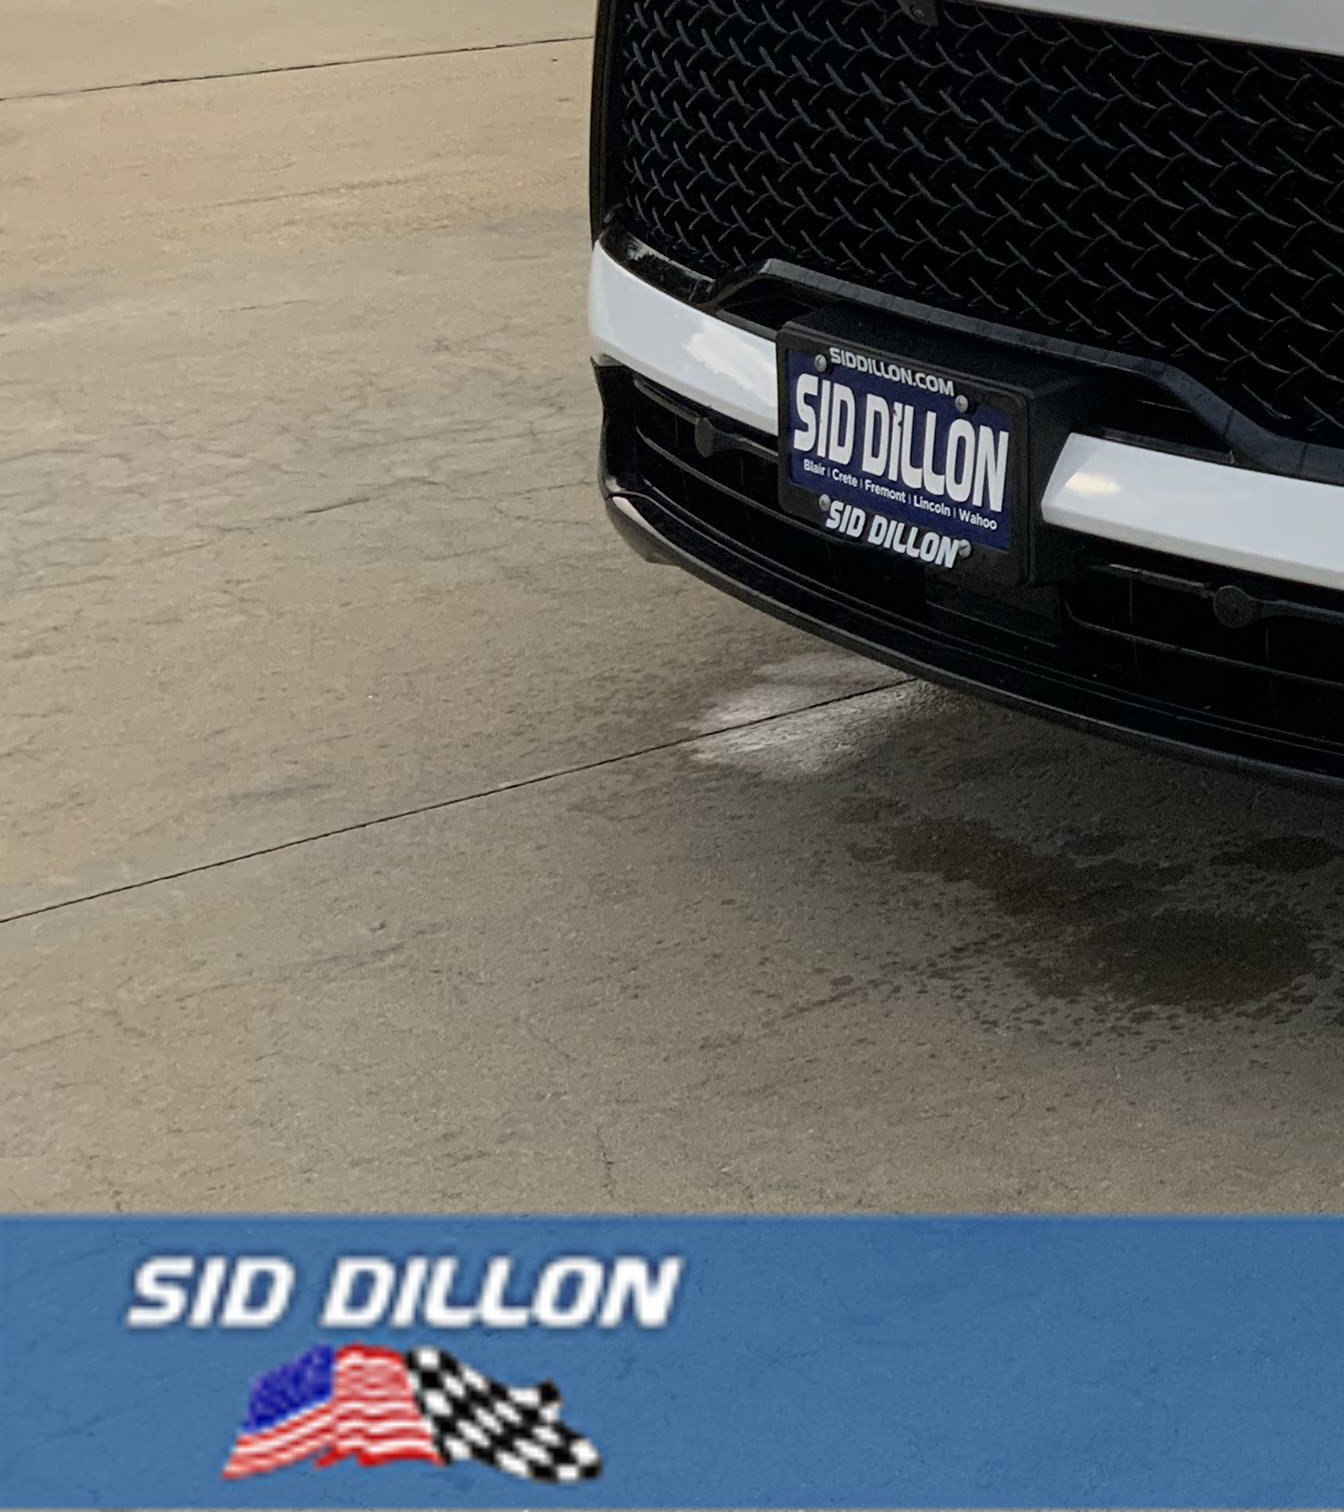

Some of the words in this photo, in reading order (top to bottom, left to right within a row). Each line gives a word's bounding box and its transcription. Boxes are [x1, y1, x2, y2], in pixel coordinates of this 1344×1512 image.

[829, 347, 954, 397] SIDDILLON.COM
[793, 373, 856, 465] SID
[861, 393, 1009, 512] DILLON
[803, 456, 826, 475] Blair
[832, 468, 858, 487] Crete
[864, 479, 906, 504] Fremont
[913, 495, 952, 517] Lincoln
[958, 508, 998, 530] Wahoo
[825, 500, 866, 538] SID
[867, 514, 960, 569] DILLON
